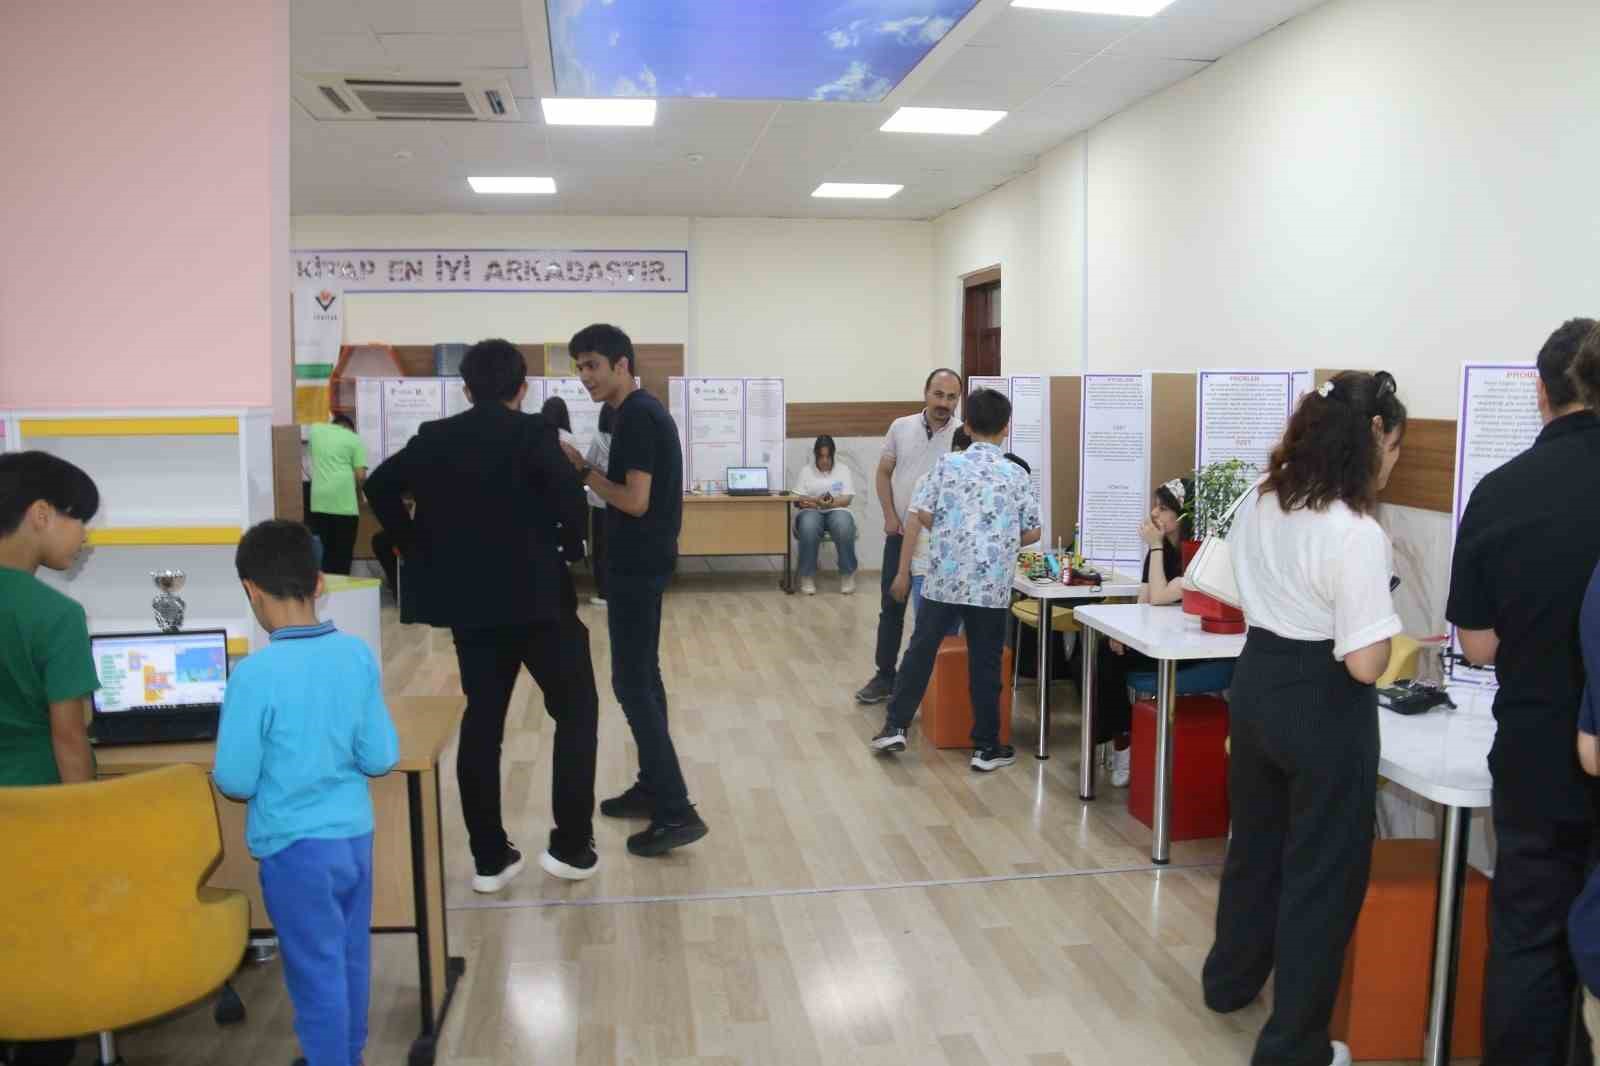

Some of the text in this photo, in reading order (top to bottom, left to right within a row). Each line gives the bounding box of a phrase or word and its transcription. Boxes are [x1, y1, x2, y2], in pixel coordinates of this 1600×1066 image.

[297, 254, 672, 286] KİTAP EN İYİ ARKADAŞTIR.
